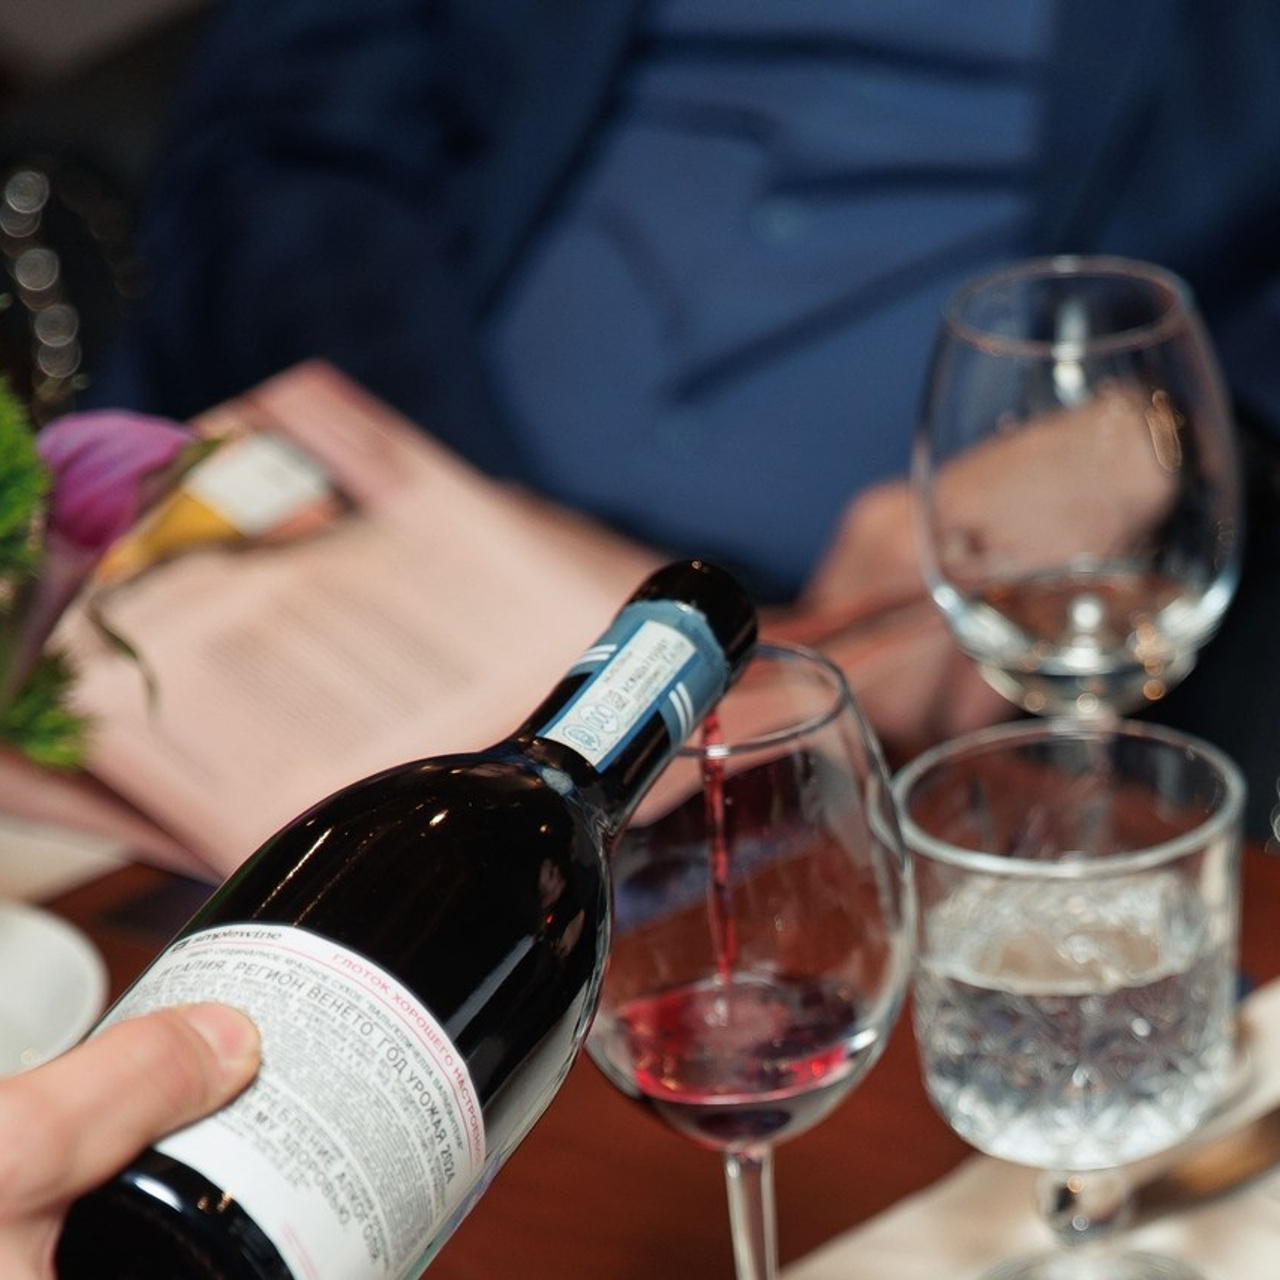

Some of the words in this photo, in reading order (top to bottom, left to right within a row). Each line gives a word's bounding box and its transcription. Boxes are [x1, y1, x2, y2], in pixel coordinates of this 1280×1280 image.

[232, 960, 306, 990] РЕГИОН
[377, 1037, 408, 1075] ГОД
[404, 1069, 448, 1145] УРОЖАЯ
[332, 953, 391, 994] ГЛОТОК
[391, 992, 454, 1067] ХОРОШЕГО
